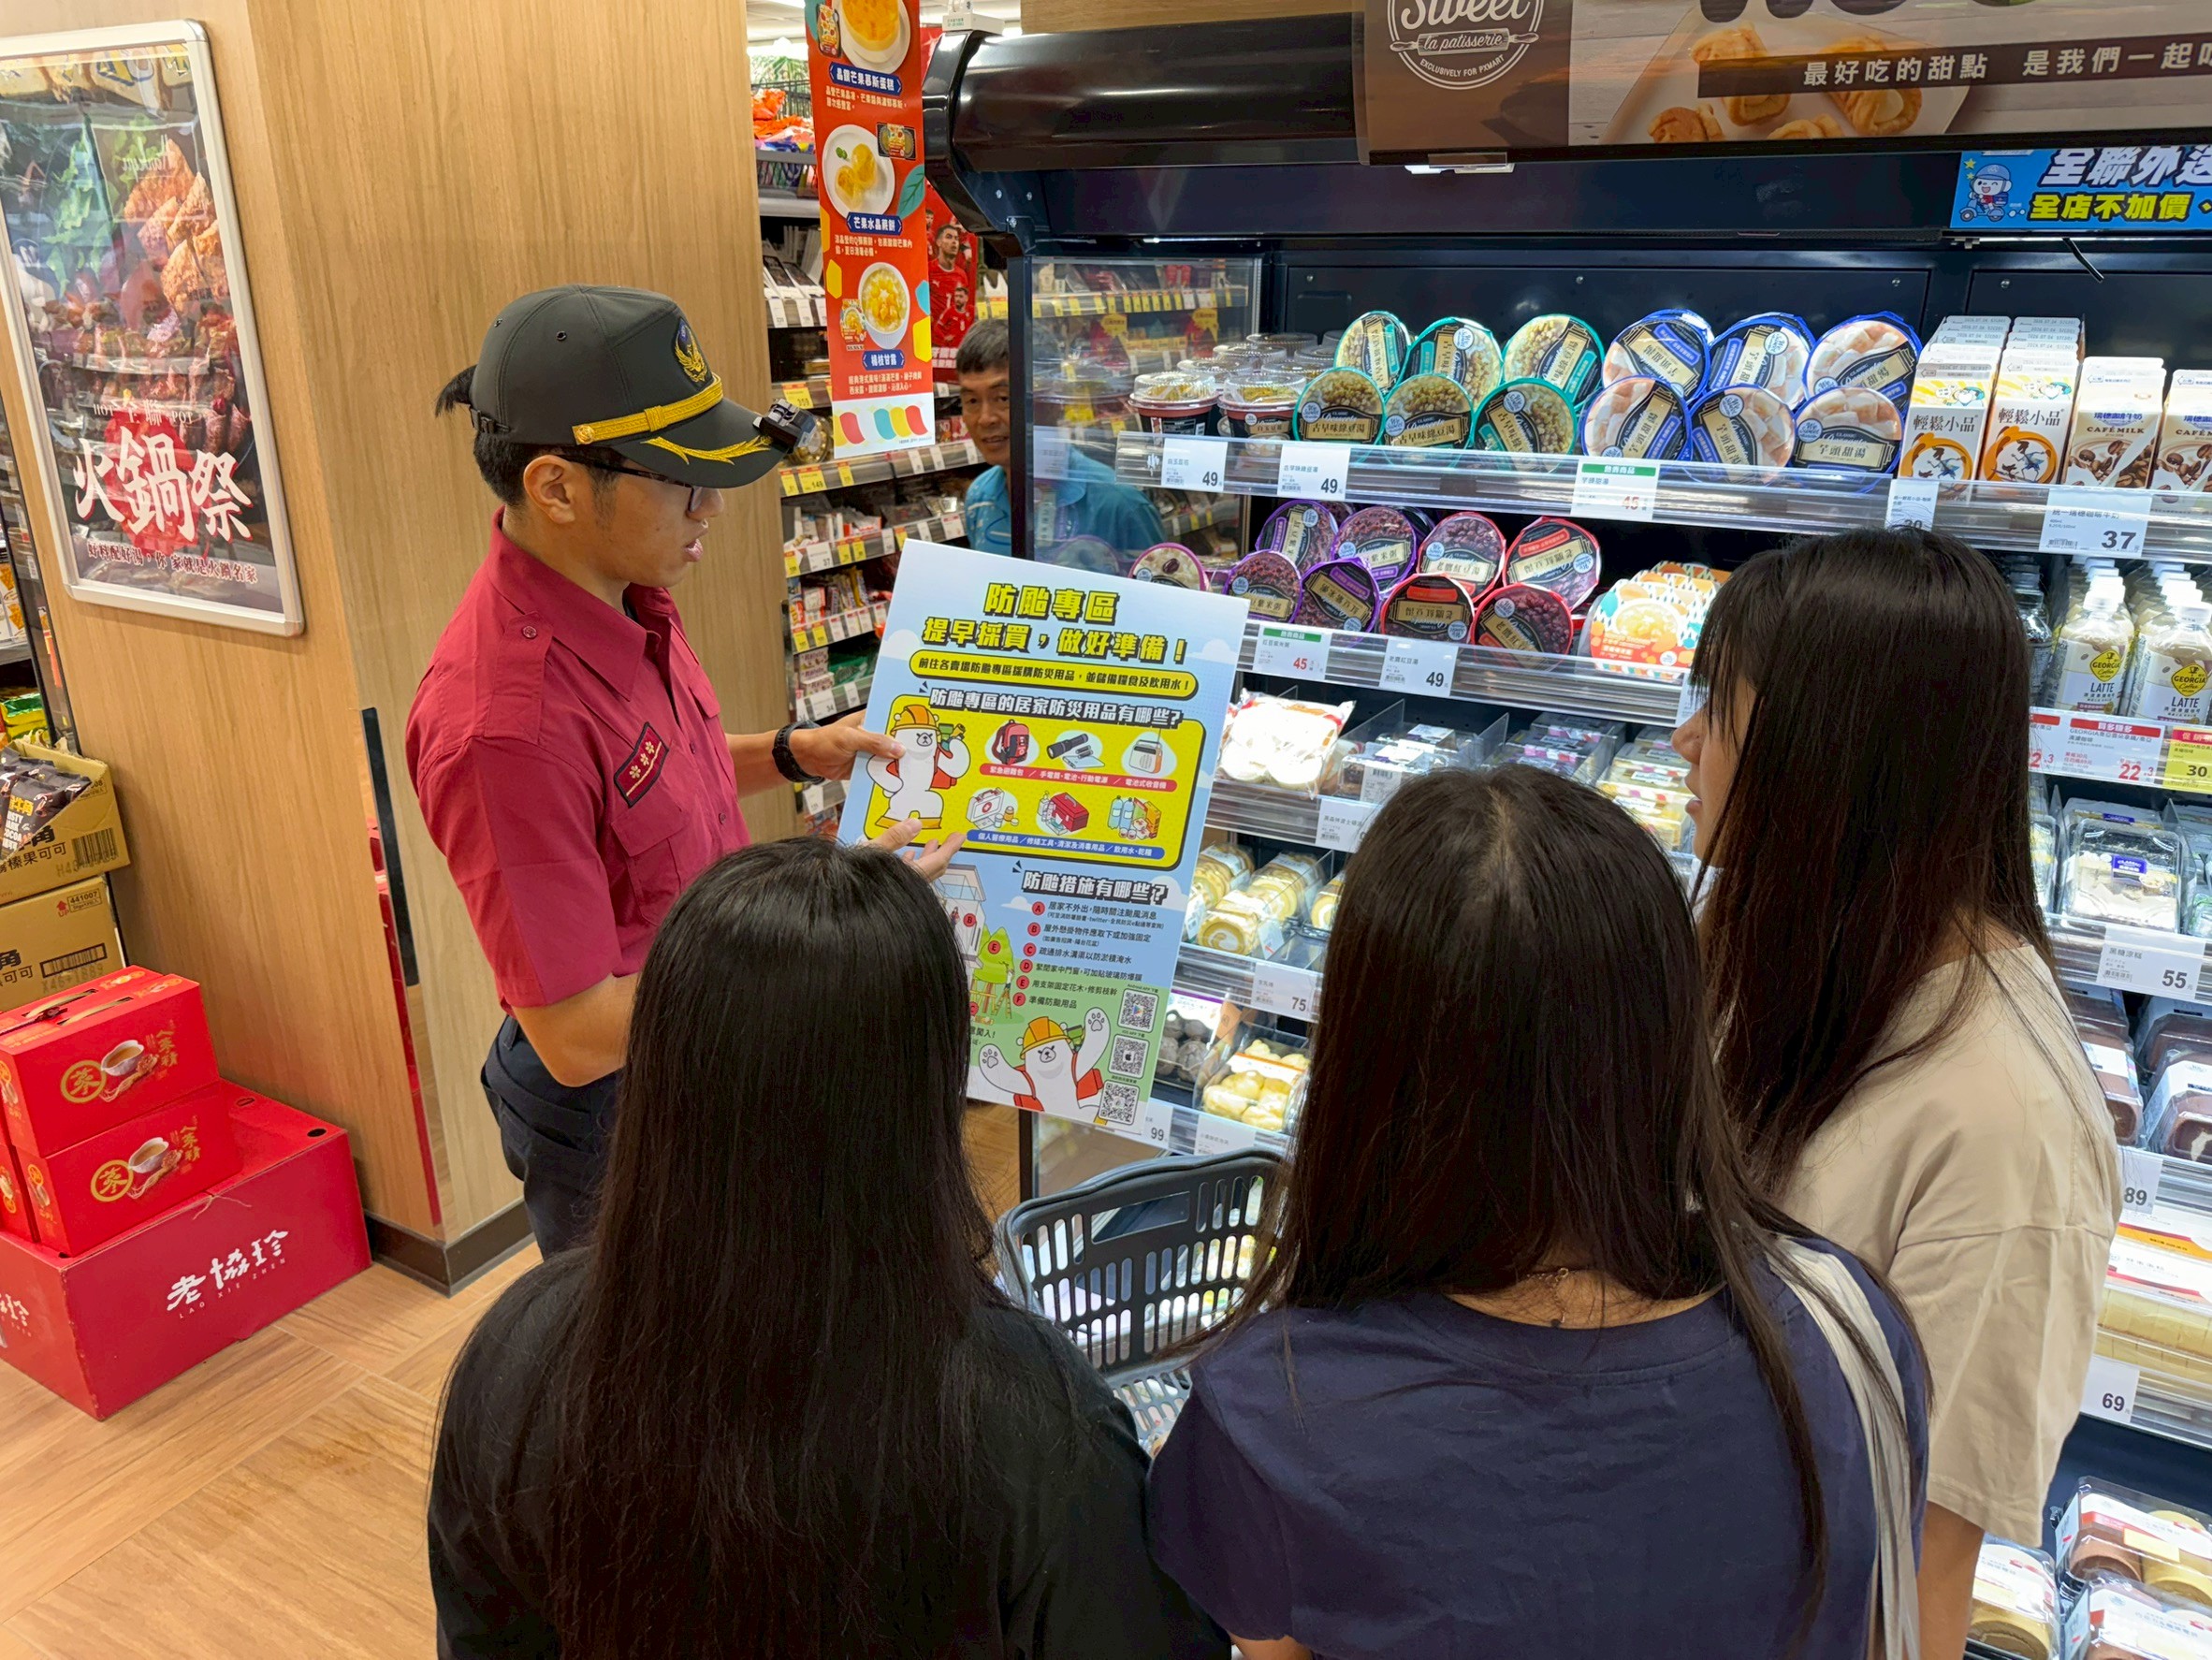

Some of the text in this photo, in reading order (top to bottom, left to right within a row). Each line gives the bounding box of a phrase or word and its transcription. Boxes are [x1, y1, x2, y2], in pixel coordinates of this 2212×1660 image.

[1423, 33, 1503, 51] la patisserie
[1419, 54, 1505, 78] EXCLUSIVELY FOR PXMART
[1804, 56, 1987, 87] 最好吃的甜點
[1913, 414, 1975, 433] 輕鬆小品
[1999, 406, 2061, 426] 輕鬆小品
[1818, 444, 1866, 459] 芋頭甜湯
[73, 426, 254, 544] 火鍋祭
[1202, 471, 1218, 487] 49
[1320, 478, 1338, 494] 49
[2101, 531, 2137, 549] 37
[983, 582, 1121, 625] 防颱專區
[922, 617, 1187, 664] 提早採買，做好準備！
[1293, 658, 1307, 670] 45
[1426, 671, 1445, 688] 49
[2090, 682, 2115, 692] LATTE
[2174, 676, 2206, 684] GEORGIA
[2172, 697, 2200, 708] LATTE
[2187, 765, 2207, 778] 30
[1022, 870, 1168, 906] 防颱措施有哪些?
[70, 892, 98, 904] 441007
[2162, 970, 2188, 989] 55
[1291, 997, 1307, 1012] 75
[1151, 1127, 1164, 1141] 99
[2124, 1187, 2147, 1206] 89
[167, 1230, 288, 1311] 老協珍
[179, 1302, 205, 1318] LAO
[217, 1282, 240, 1299] XIE
[0, 1293, 29, 1326] 珍
[2103, 1392, 2125, 1411] 69
